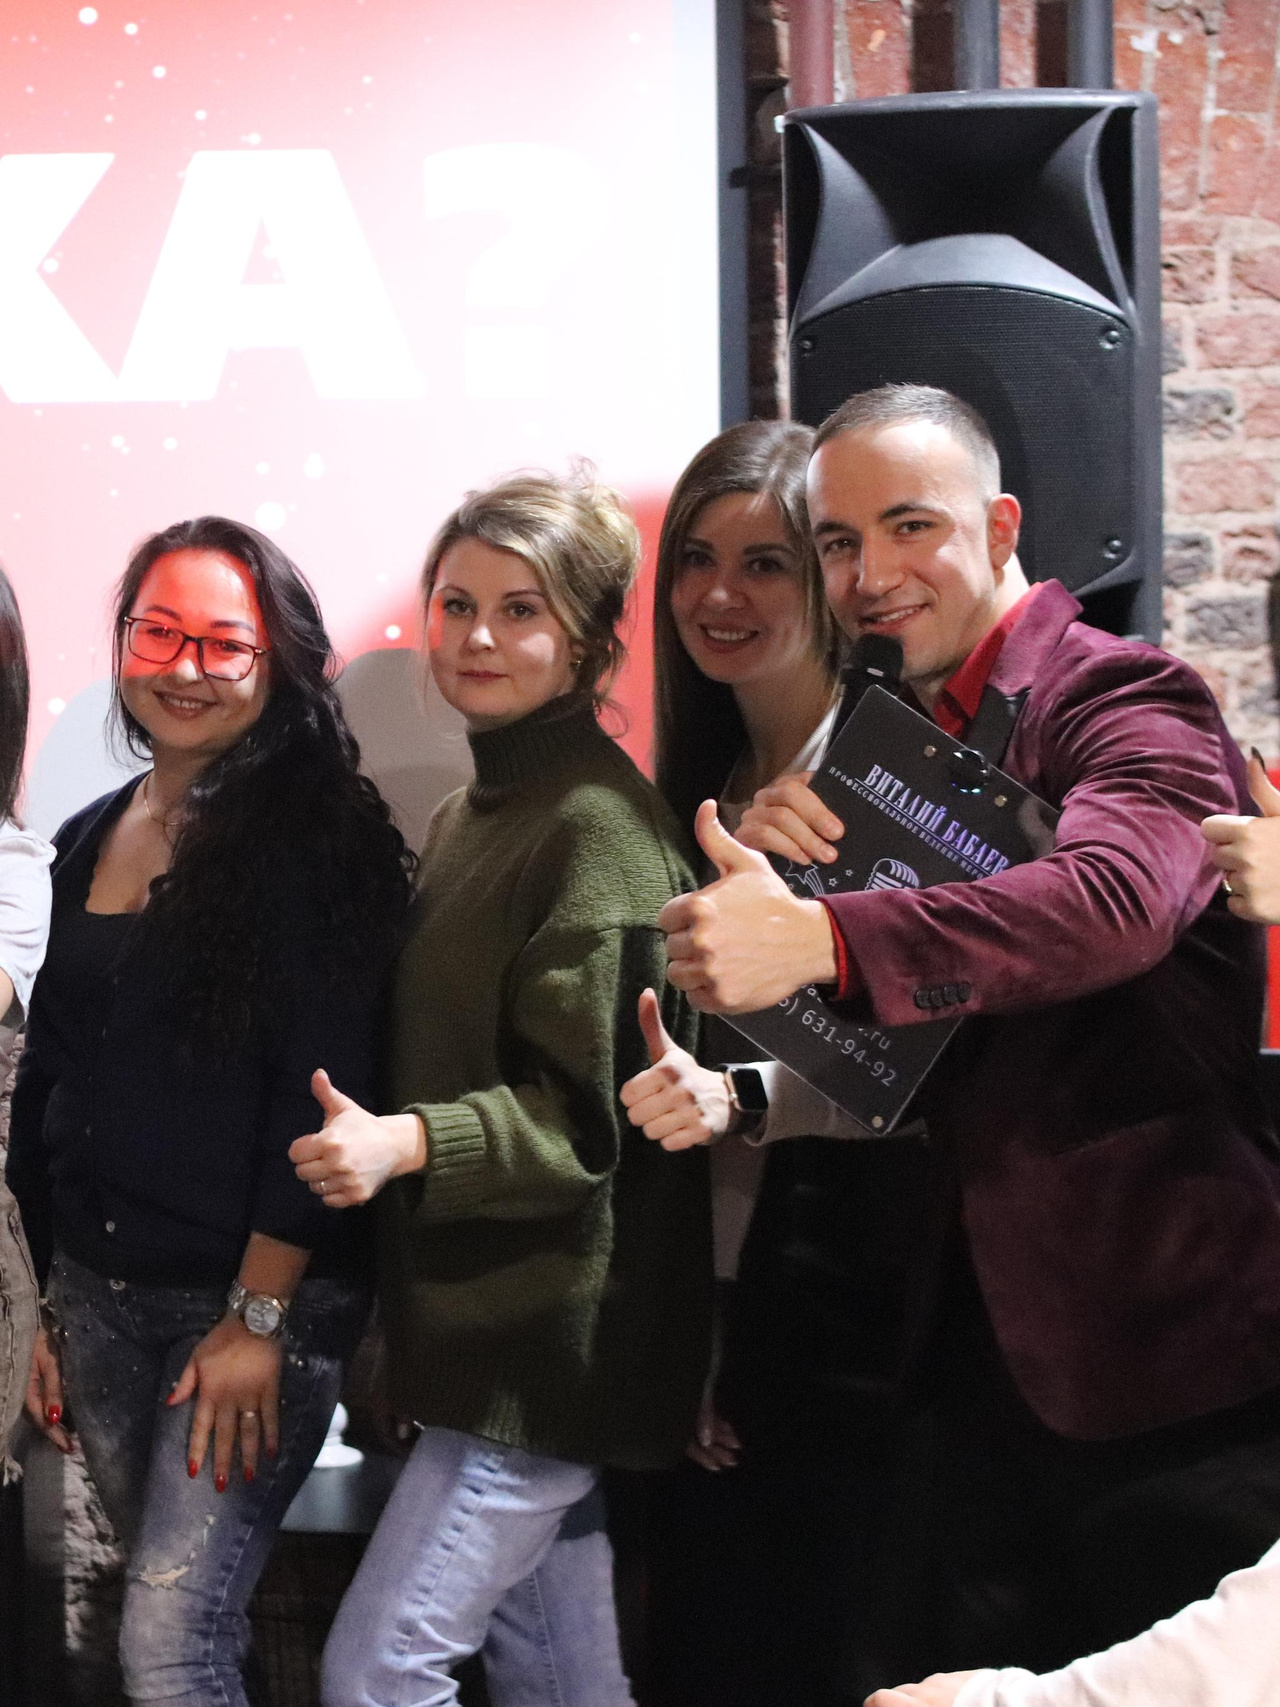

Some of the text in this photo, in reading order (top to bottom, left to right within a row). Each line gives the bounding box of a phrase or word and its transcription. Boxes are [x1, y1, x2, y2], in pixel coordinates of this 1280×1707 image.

[828, 766, 919, 834] ПРОФЕССИОНАЛЬНОЕ
[919, 831, 959, 863] ВЕДЕНИЕ
[864, 763, 948, 832] ВИТАЛИЙ
[801, 1009, 896, 1087] 631-94-92
